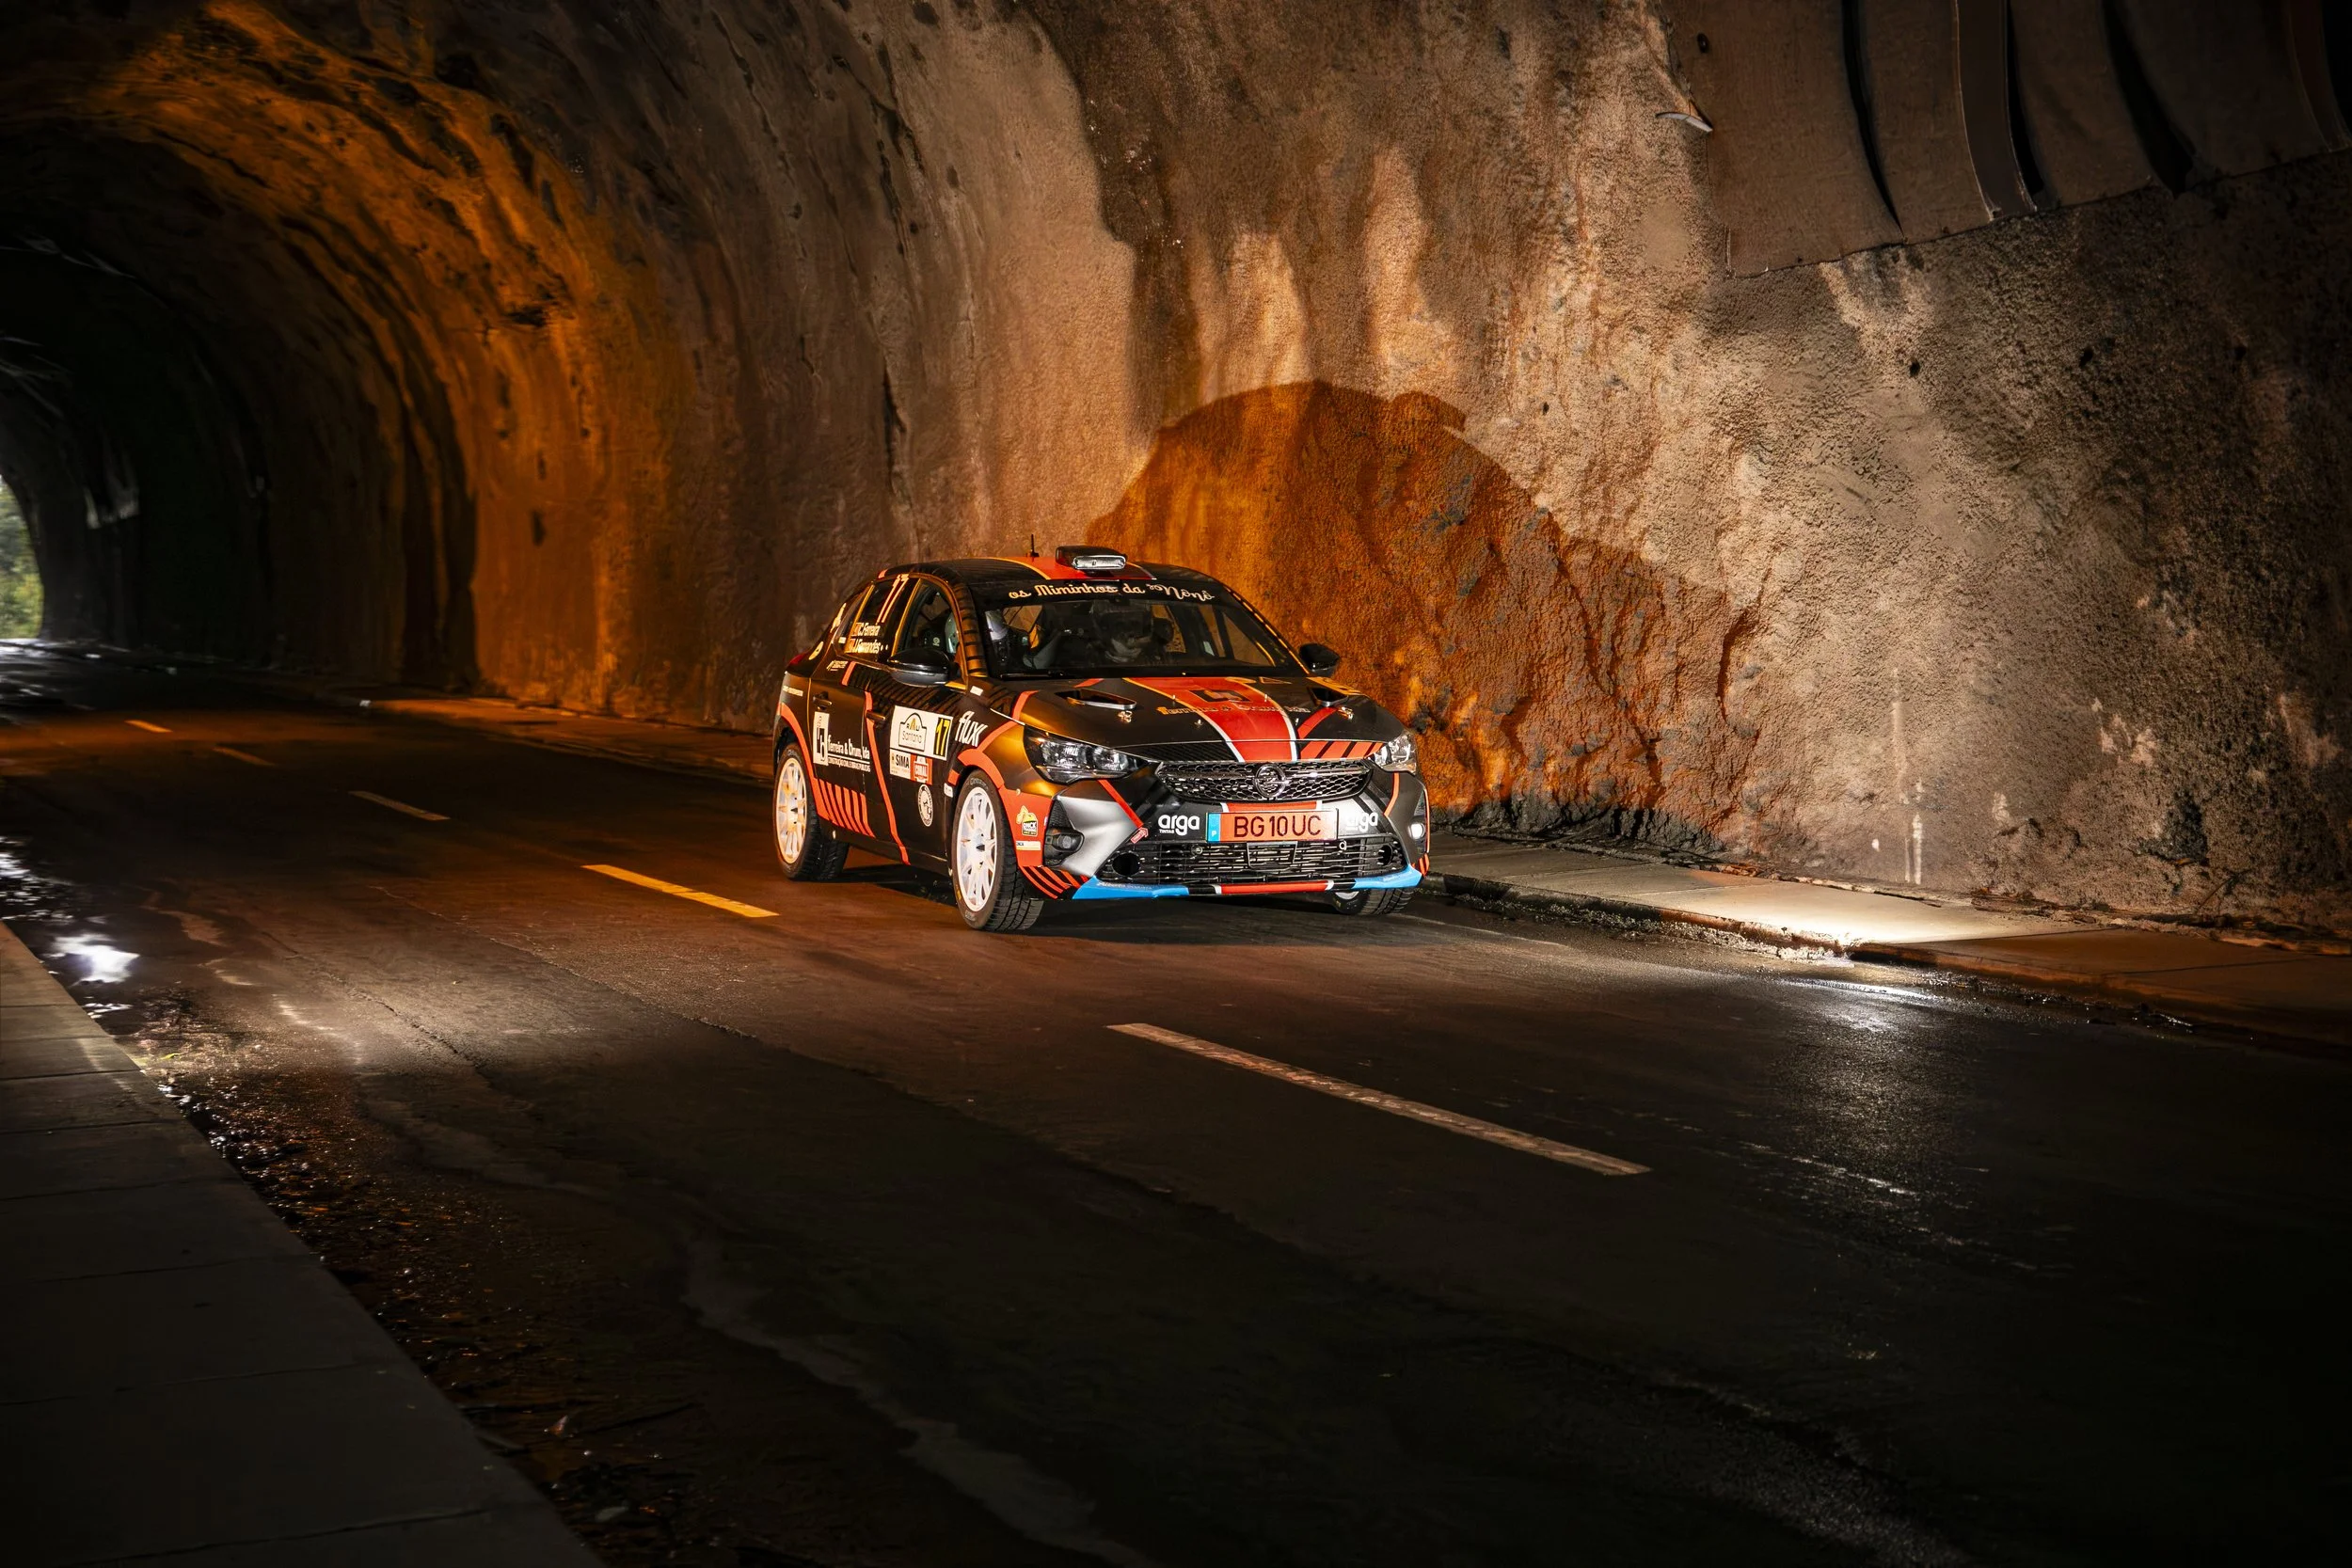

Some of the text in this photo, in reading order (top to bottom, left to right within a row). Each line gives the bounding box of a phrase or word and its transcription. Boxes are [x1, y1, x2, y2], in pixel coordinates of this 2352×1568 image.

[1122, 583, 1145, 594] da
[936, 718, 950, 756] 17
[896, 754, 909, 768] SIMA
[1157, 814, 1200, 836] arga
[1233, 815, 1321, 837] BG 10 UC
